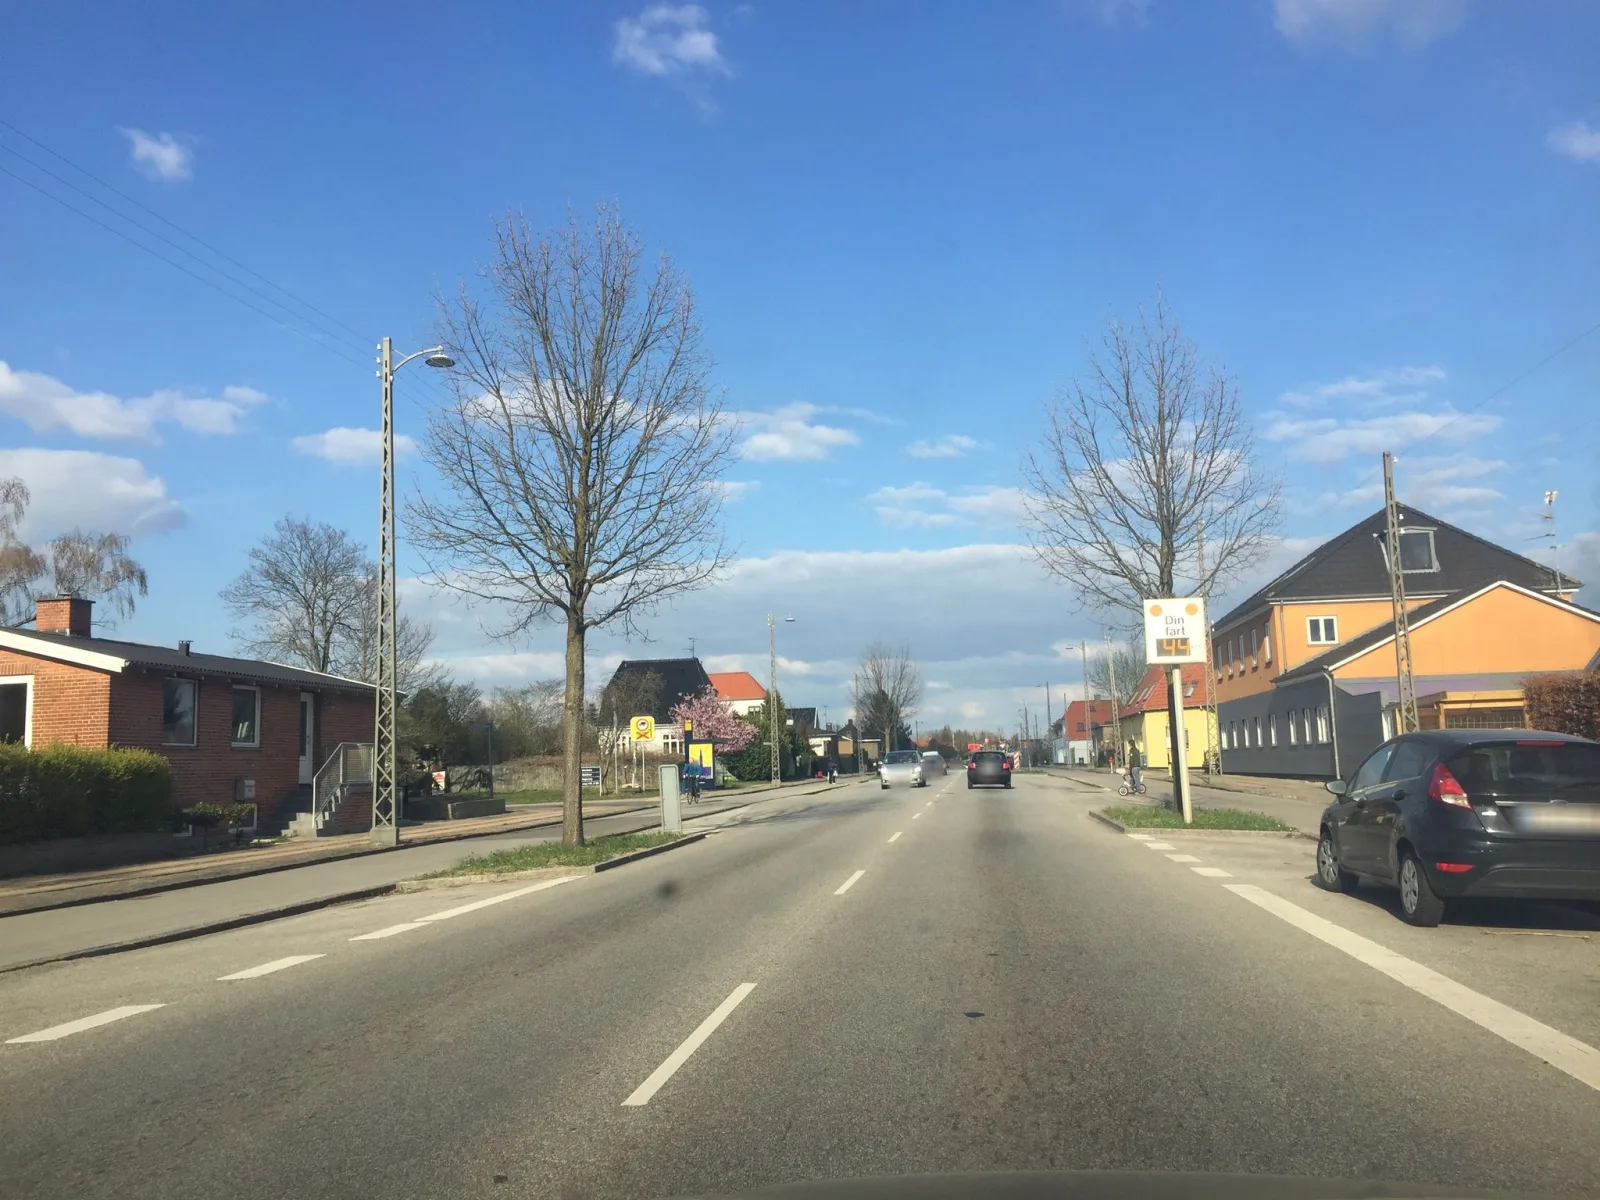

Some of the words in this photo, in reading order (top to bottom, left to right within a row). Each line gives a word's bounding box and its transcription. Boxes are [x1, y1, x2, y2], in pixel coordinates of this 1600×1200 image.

[1165, 615, 1185, 625] Din
[1165, 626, 1186, 636] fart
[1162, 639, 1190, 656] 44
